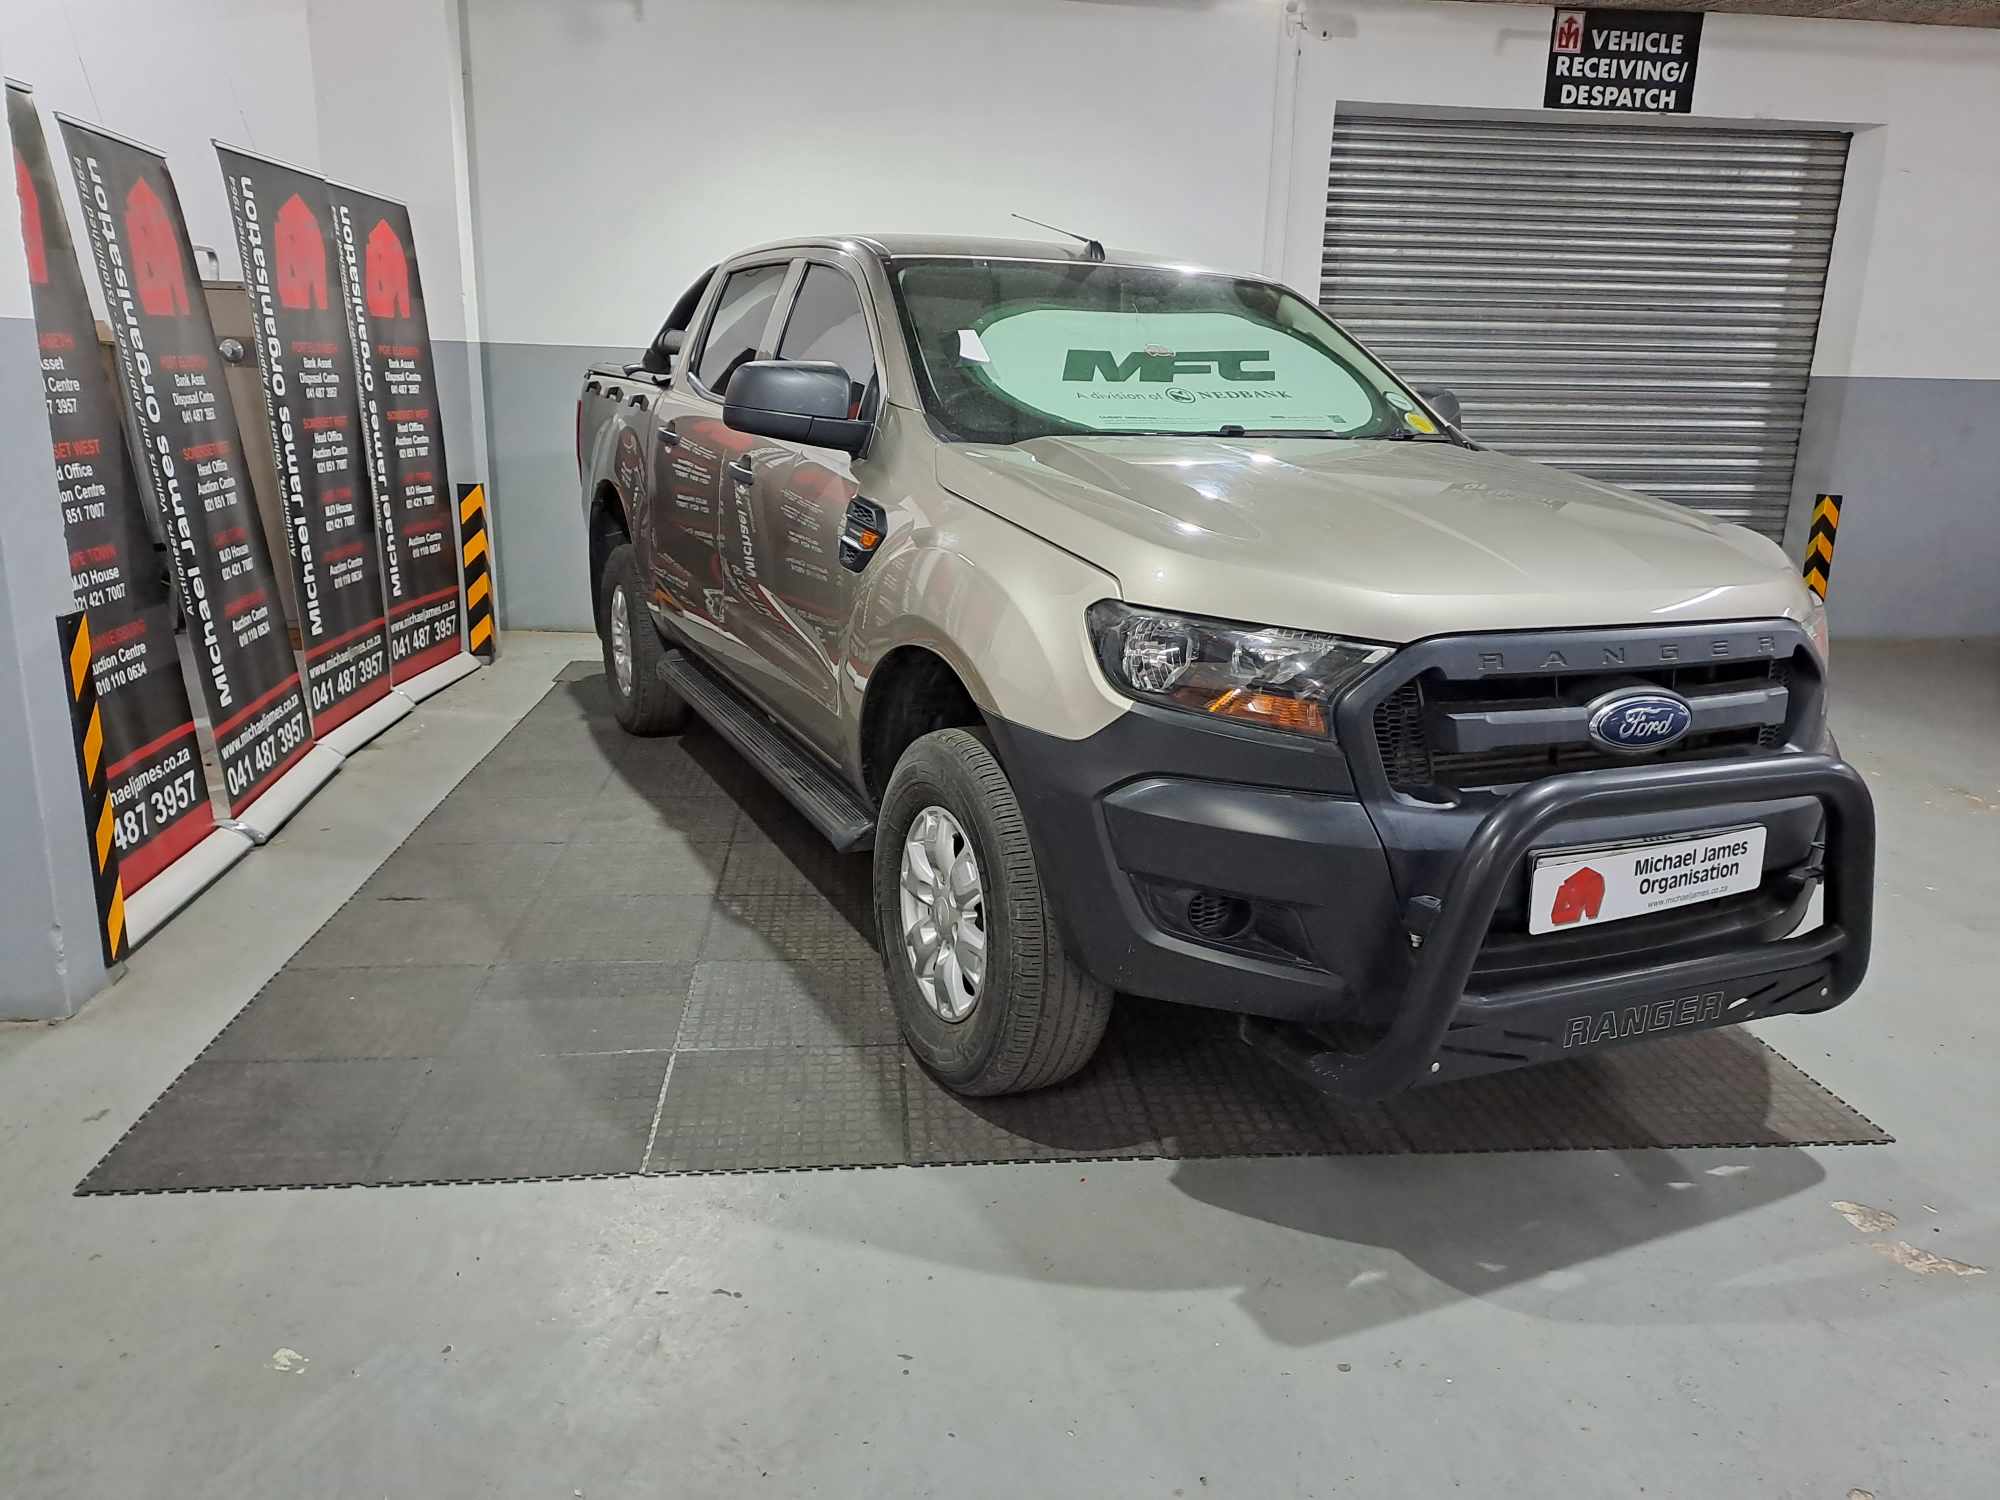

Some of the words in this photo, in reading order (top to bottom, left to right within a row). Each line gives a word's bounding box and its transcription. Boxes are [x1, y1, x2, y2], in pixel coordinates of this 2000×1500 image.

[1591, 28, 1684, 55] VEHICLE
[1555, 55, 1689, 83] RECEIVING/
[1560, 84, 1676, 110] DESPATCH
[87, 157, 161, 424] Organisation
[240, 176, 287, 396] Organisation
[340, 205, 374, 392] Organisation
[115, 323, 146, 412] Appraisers
[1062, 349, 1276, 383] MFC
[47, 377, 80, 392] Centre
[1075, 391, 1089, 401] A
[1090, 391, 1146, 401] division
[1149, 391, 1163, 401] of
[1198, 390, 1293, 400] NEDBANK
[57, 398, 77, 414] 3957
[138, 416, 152, 449] and
[368, 400, 388, 487] James
[65, 463, 94, 479] Office
[278, 406, 304, 507] James
[74, 482, 106, 500] Centre
[149, 453, 168, 513] Valuers
[157, 435, 196, 556] James
[66, 507, 83, 525] 851
[380, 495, 402, 597] Michael
[89, 567, 120, 585] House
[294, 516, 324, 636] Michael
[89, 589, 105, 607] 421
[105, 582, 126, 602] 7007
[187, 566, 233, 708] Michael
[392, 636, 411, 661] 041
[412, 624, 430, 649] 487
[434, 614, 457, 641] 3957
[1478, 635, 1776, 671] RANGER
[92, 652, 118, 676] uction
[118, 642, 147, 663] Centre
[96, 676, 111, 696] 010
[110, 670, 126, 689] 110
[127, 661, 147, 683] 0634
[312, 678, 335, 710] 041
[337, 666, 356, 695] 487
[358, 651, 383, 683] 3957
[221, 693, 300, 760] www.michaeljames.co.za
[1619, 705, 1674, 739] Ford
[227, 754, 254, 796] 041
[255, 733, 278, 773] 487
[278, 711, 306, 754] 3957
[114, 801, 149, 850] 487
[151, 769, 196, 824] 3957
[1634, 848, 1697, 876] Michael
[1700, 840, 1748, 863] James
[1639, 861, 1740, 895] Organisation
[1563, 991, 1725, 1048] RANGER
